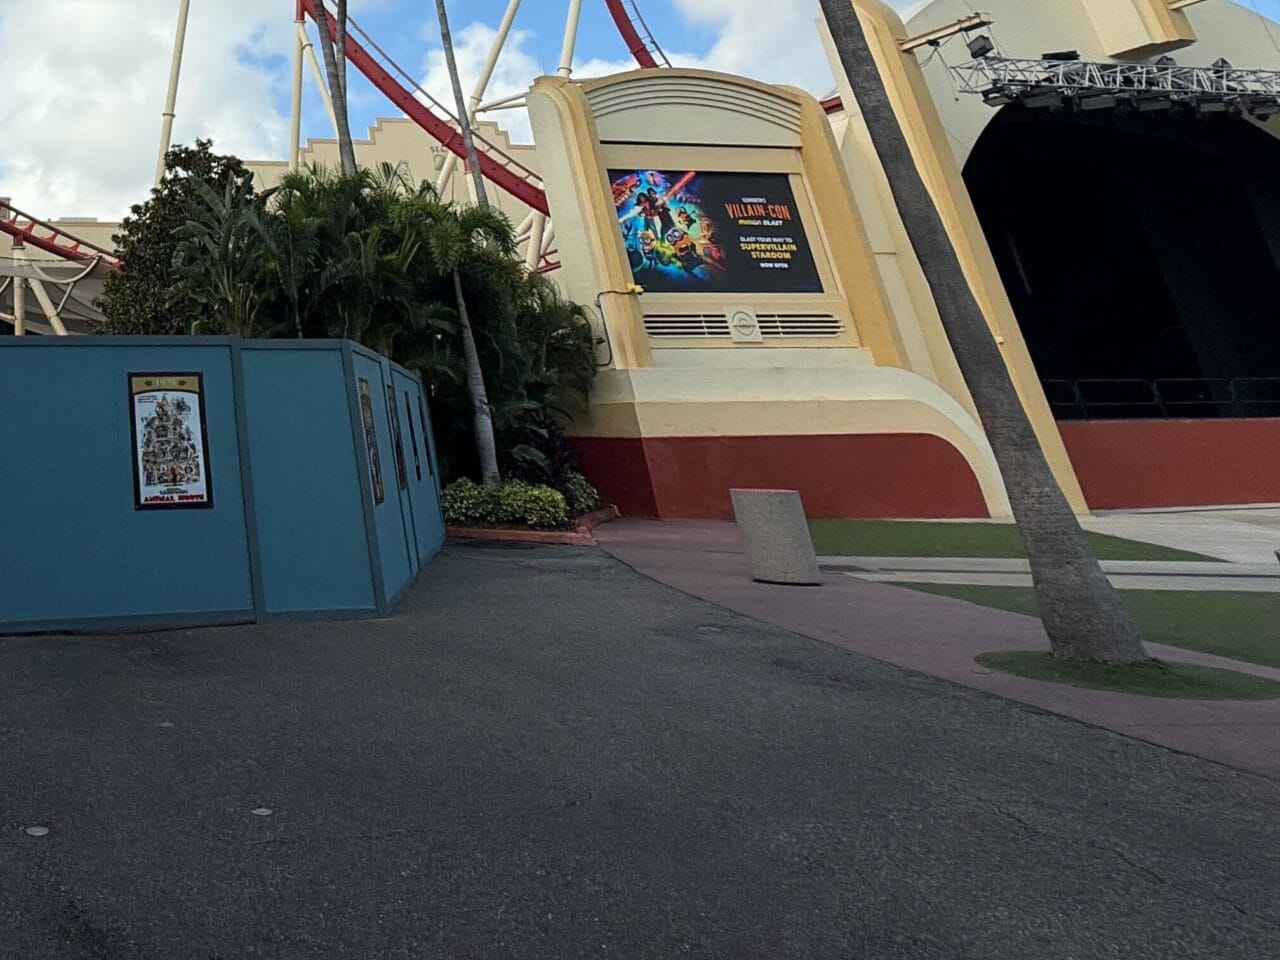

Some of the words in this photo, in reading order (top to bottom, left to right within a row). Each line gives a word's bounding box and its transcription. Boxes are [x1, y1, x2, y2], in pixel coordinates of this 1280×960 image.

[725, 203, 791, 220] VILLAIN-CON
[740, 243, 797, 251] SUPERVILLAIN
[751, 251, 791, 259] STARDOM
